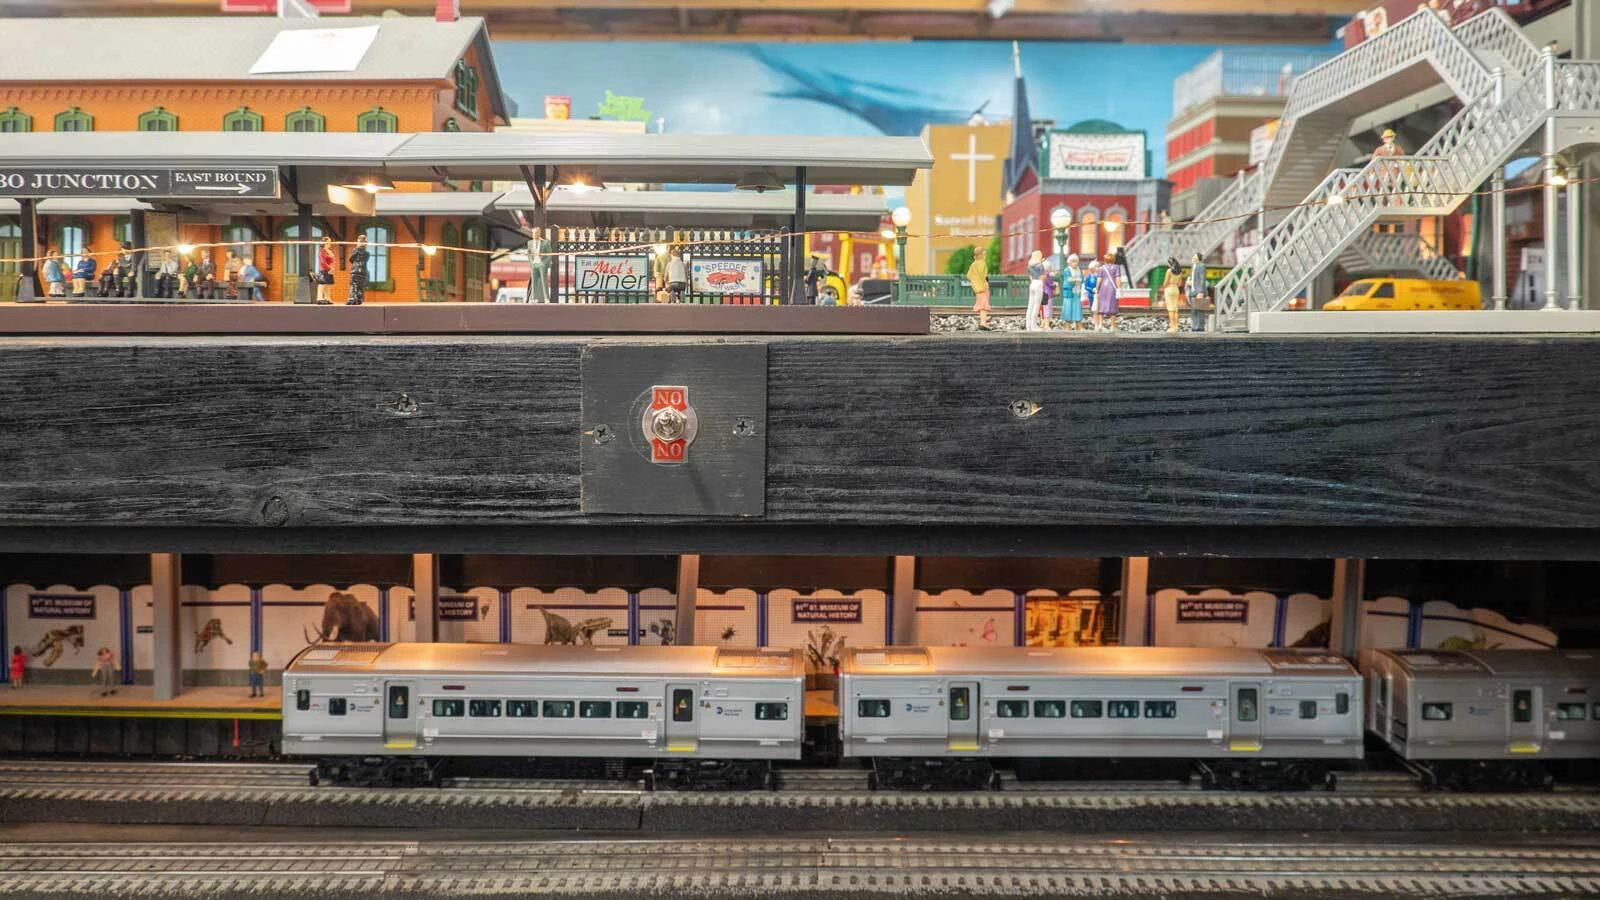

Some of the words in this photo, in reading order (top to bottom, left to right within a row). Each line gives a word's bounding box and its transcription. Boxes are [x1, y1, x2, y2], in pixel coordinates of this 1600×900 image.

[31, 173, 159, 190] JUNCTION
[175, 172, 212, 182] EAST
[215, 172, 266, 182] BOUND
[581, 259, 592, 267] Eat
[591, 259, 633, 277] Mel's
[581, 270, 647, 290] Diner
[657, 391, 682, 405] NO
[657, 443, 682, 457] NO
[797, 611, 827, 619] NATURAL
[828, 611, 858, 619] HISTORY
